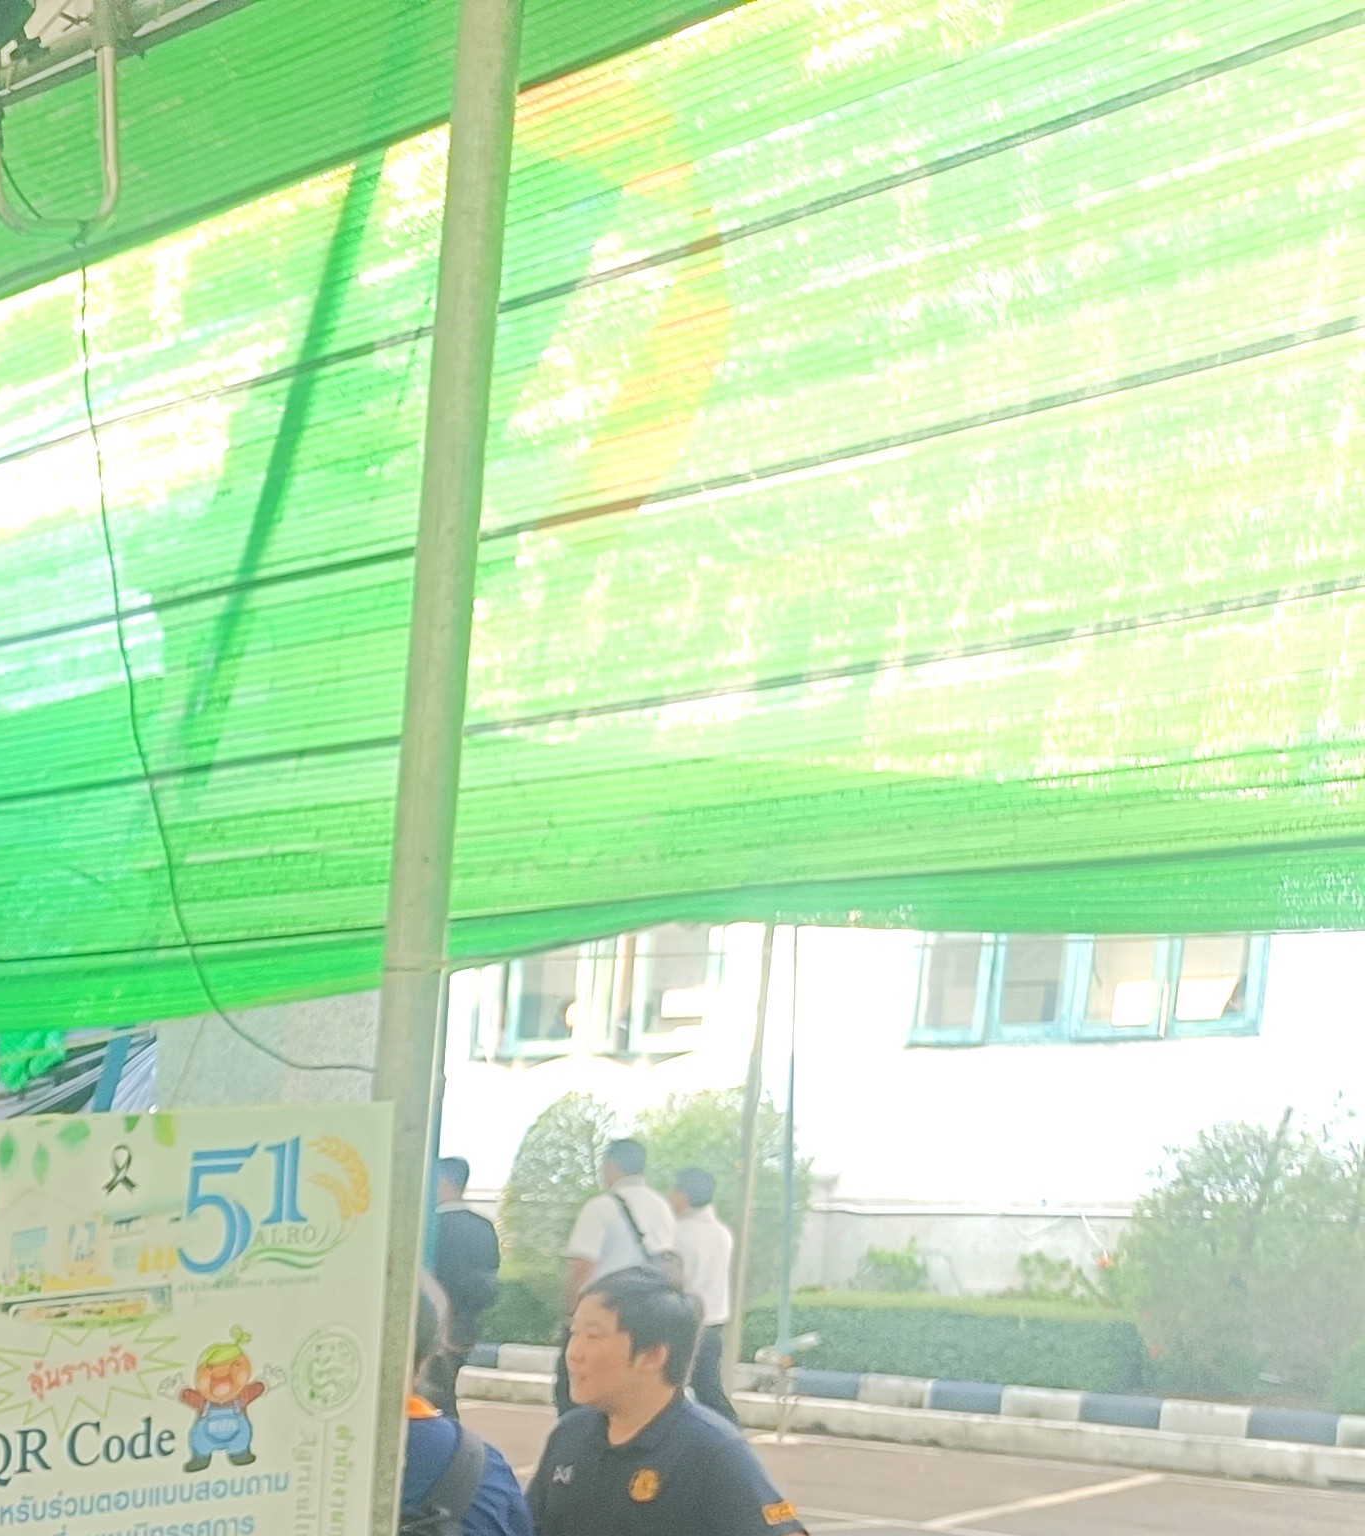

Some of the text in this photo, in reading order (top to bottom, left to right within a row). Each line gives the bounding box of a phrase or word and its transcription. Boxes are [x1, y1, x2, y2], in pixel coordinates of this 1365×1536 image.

[177, 1136, 307, 1275] 51
[27, 1344, 137, 1402] ลุ้นรางวัล
[67, 1416, 176, 1467] Code
